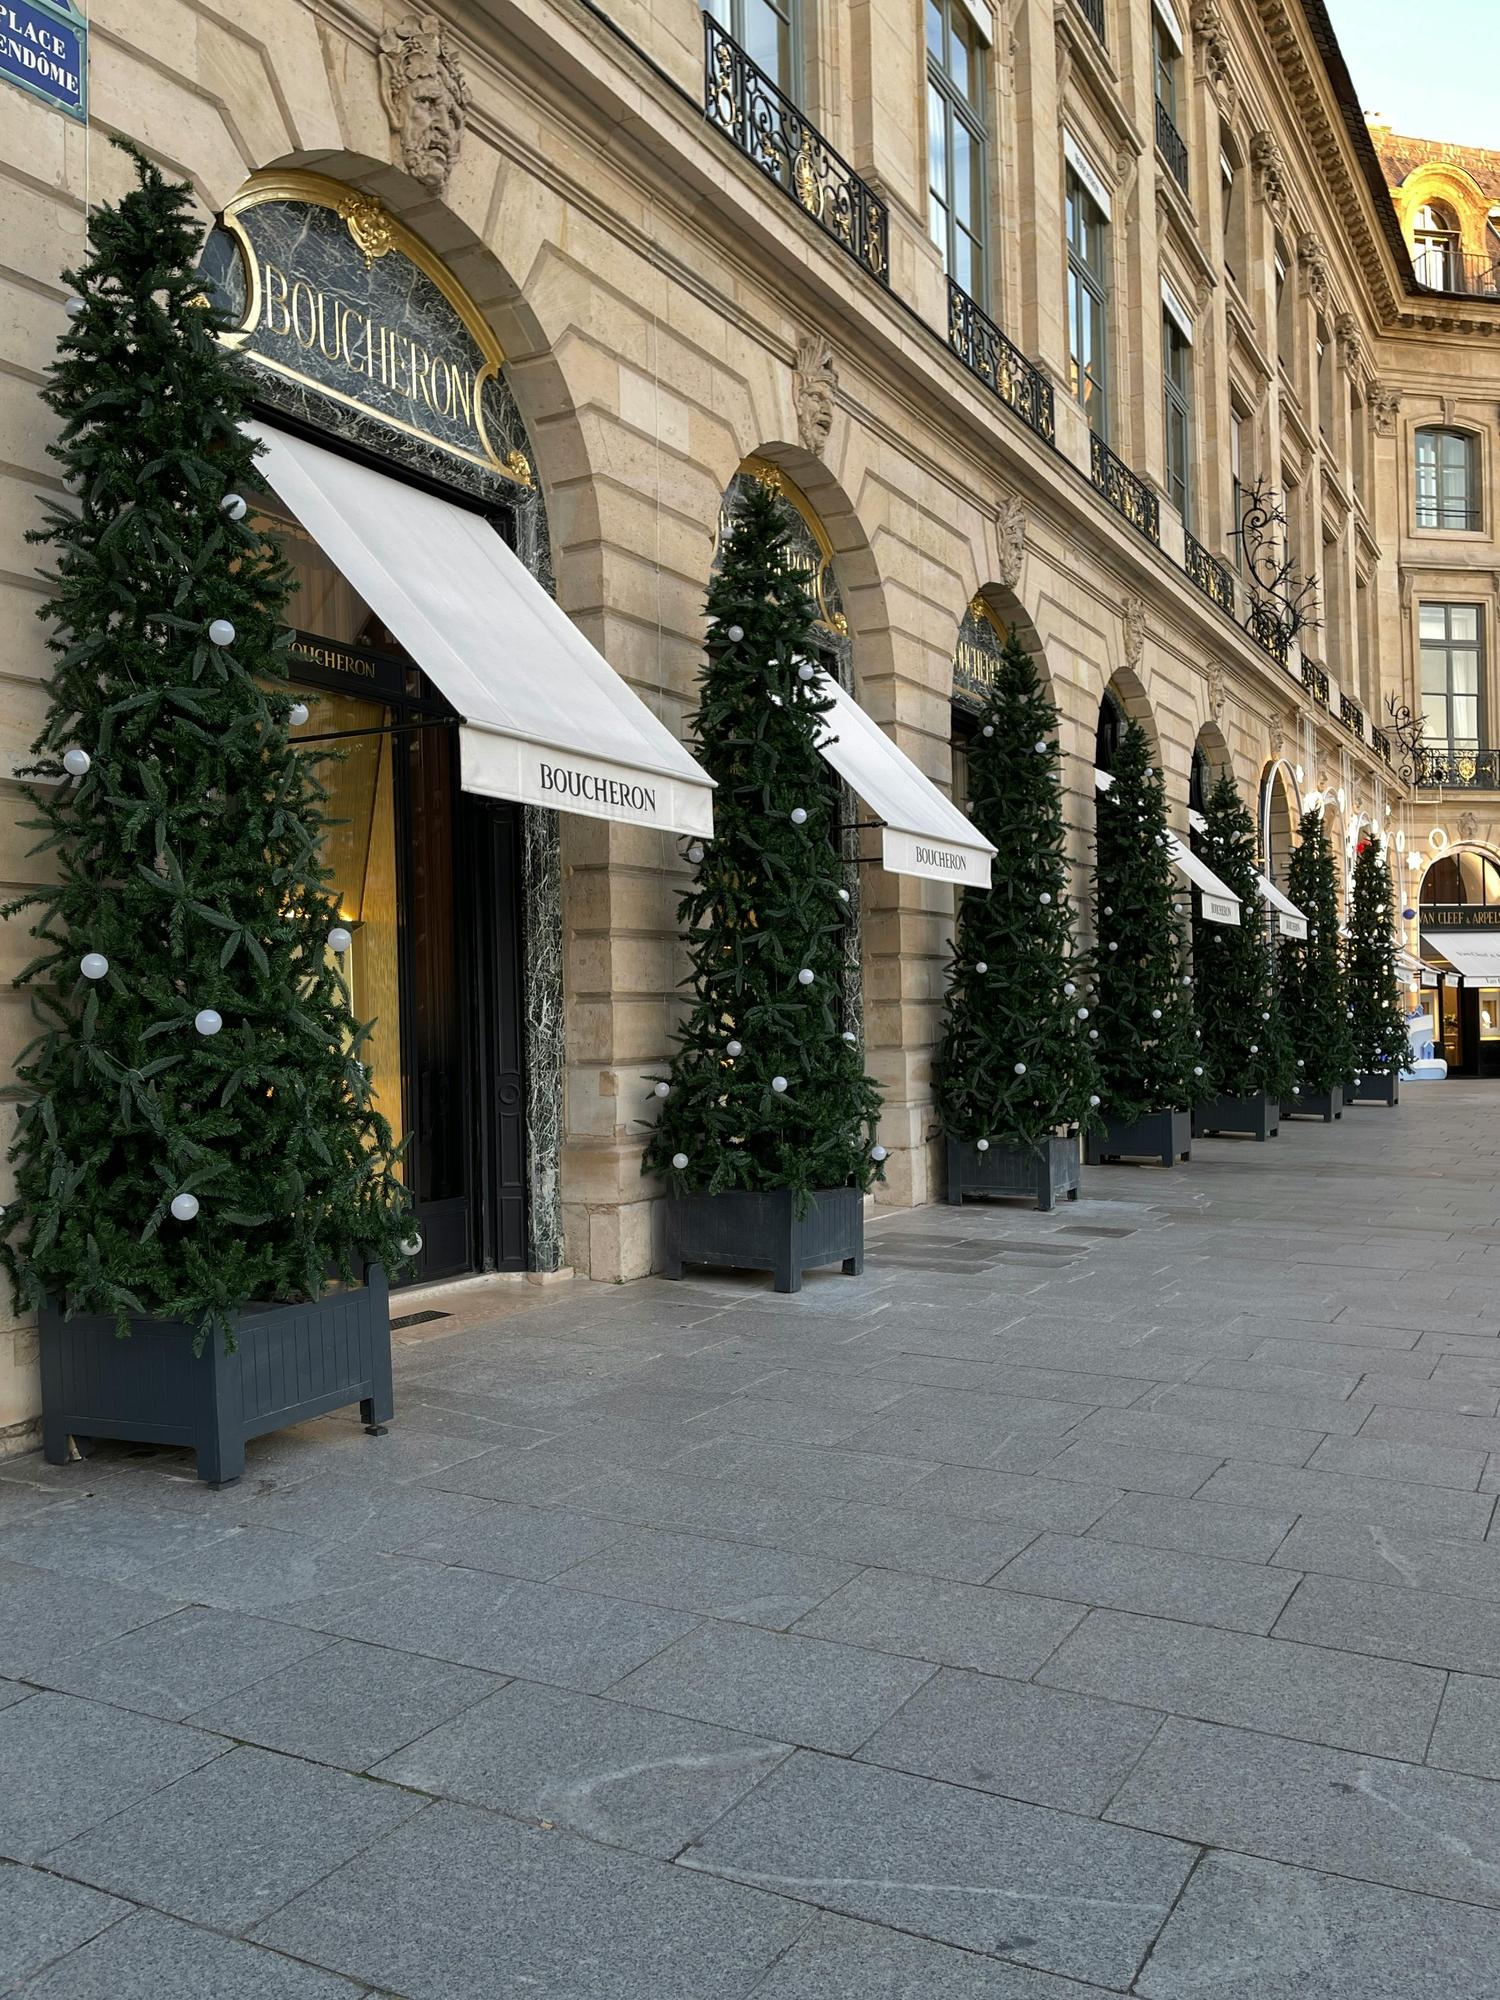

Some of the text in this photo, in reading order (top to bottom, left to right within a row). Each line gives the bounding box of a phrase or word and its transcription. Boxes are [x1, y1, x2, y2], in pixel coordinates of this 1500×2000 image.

[0, 33, 79, 95] ENDÔME
[265, 263, 471, 427] BOUCHERON
[288, 641, 376, 678] OUCHERON
[540, 763, 657, 813] BOUCHERON
[915, 846, 967, 870] BOUCHERON
[1438, 911, 1464, 925] CLEEF
